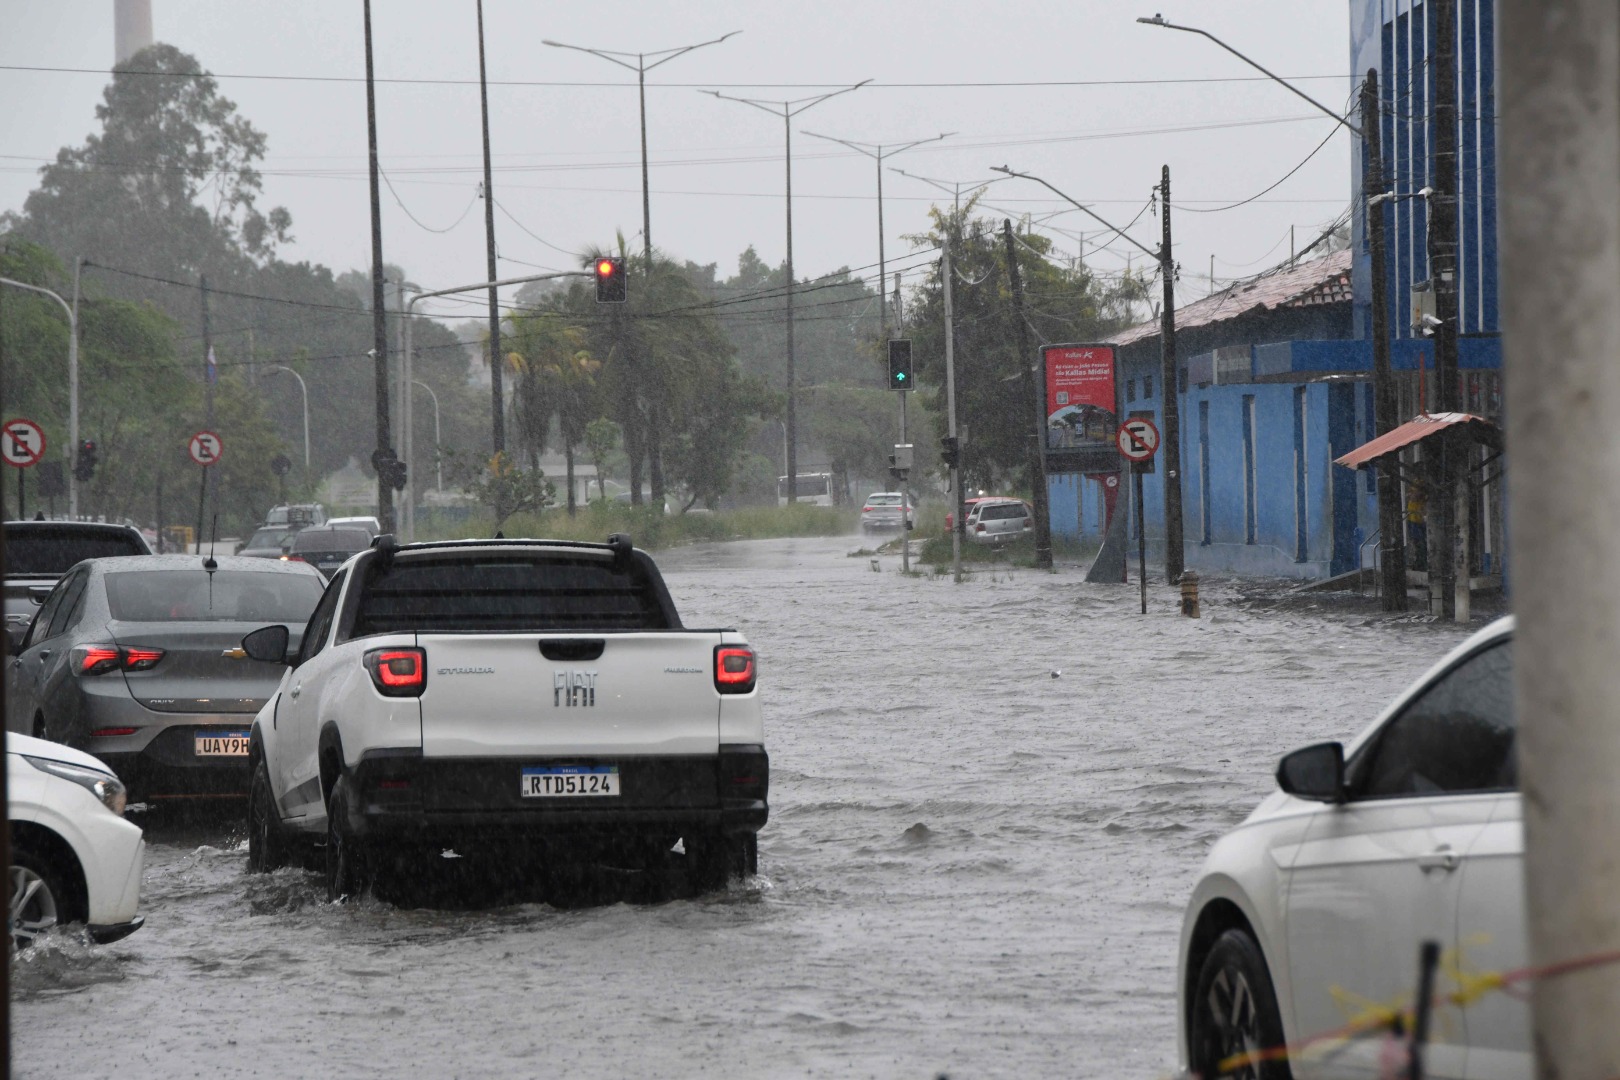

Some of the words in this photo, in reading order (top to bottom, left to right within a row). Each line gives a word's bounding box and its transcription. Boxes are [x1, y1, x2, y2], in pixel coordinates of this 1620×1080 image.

[12, 430, 29, 456] E
[199, 438, 212, 458] E
[1130, 427, 1145, 452] E
[437, 666, 495, 675] STRADA
[554, 670, 598, 707] FIAT
